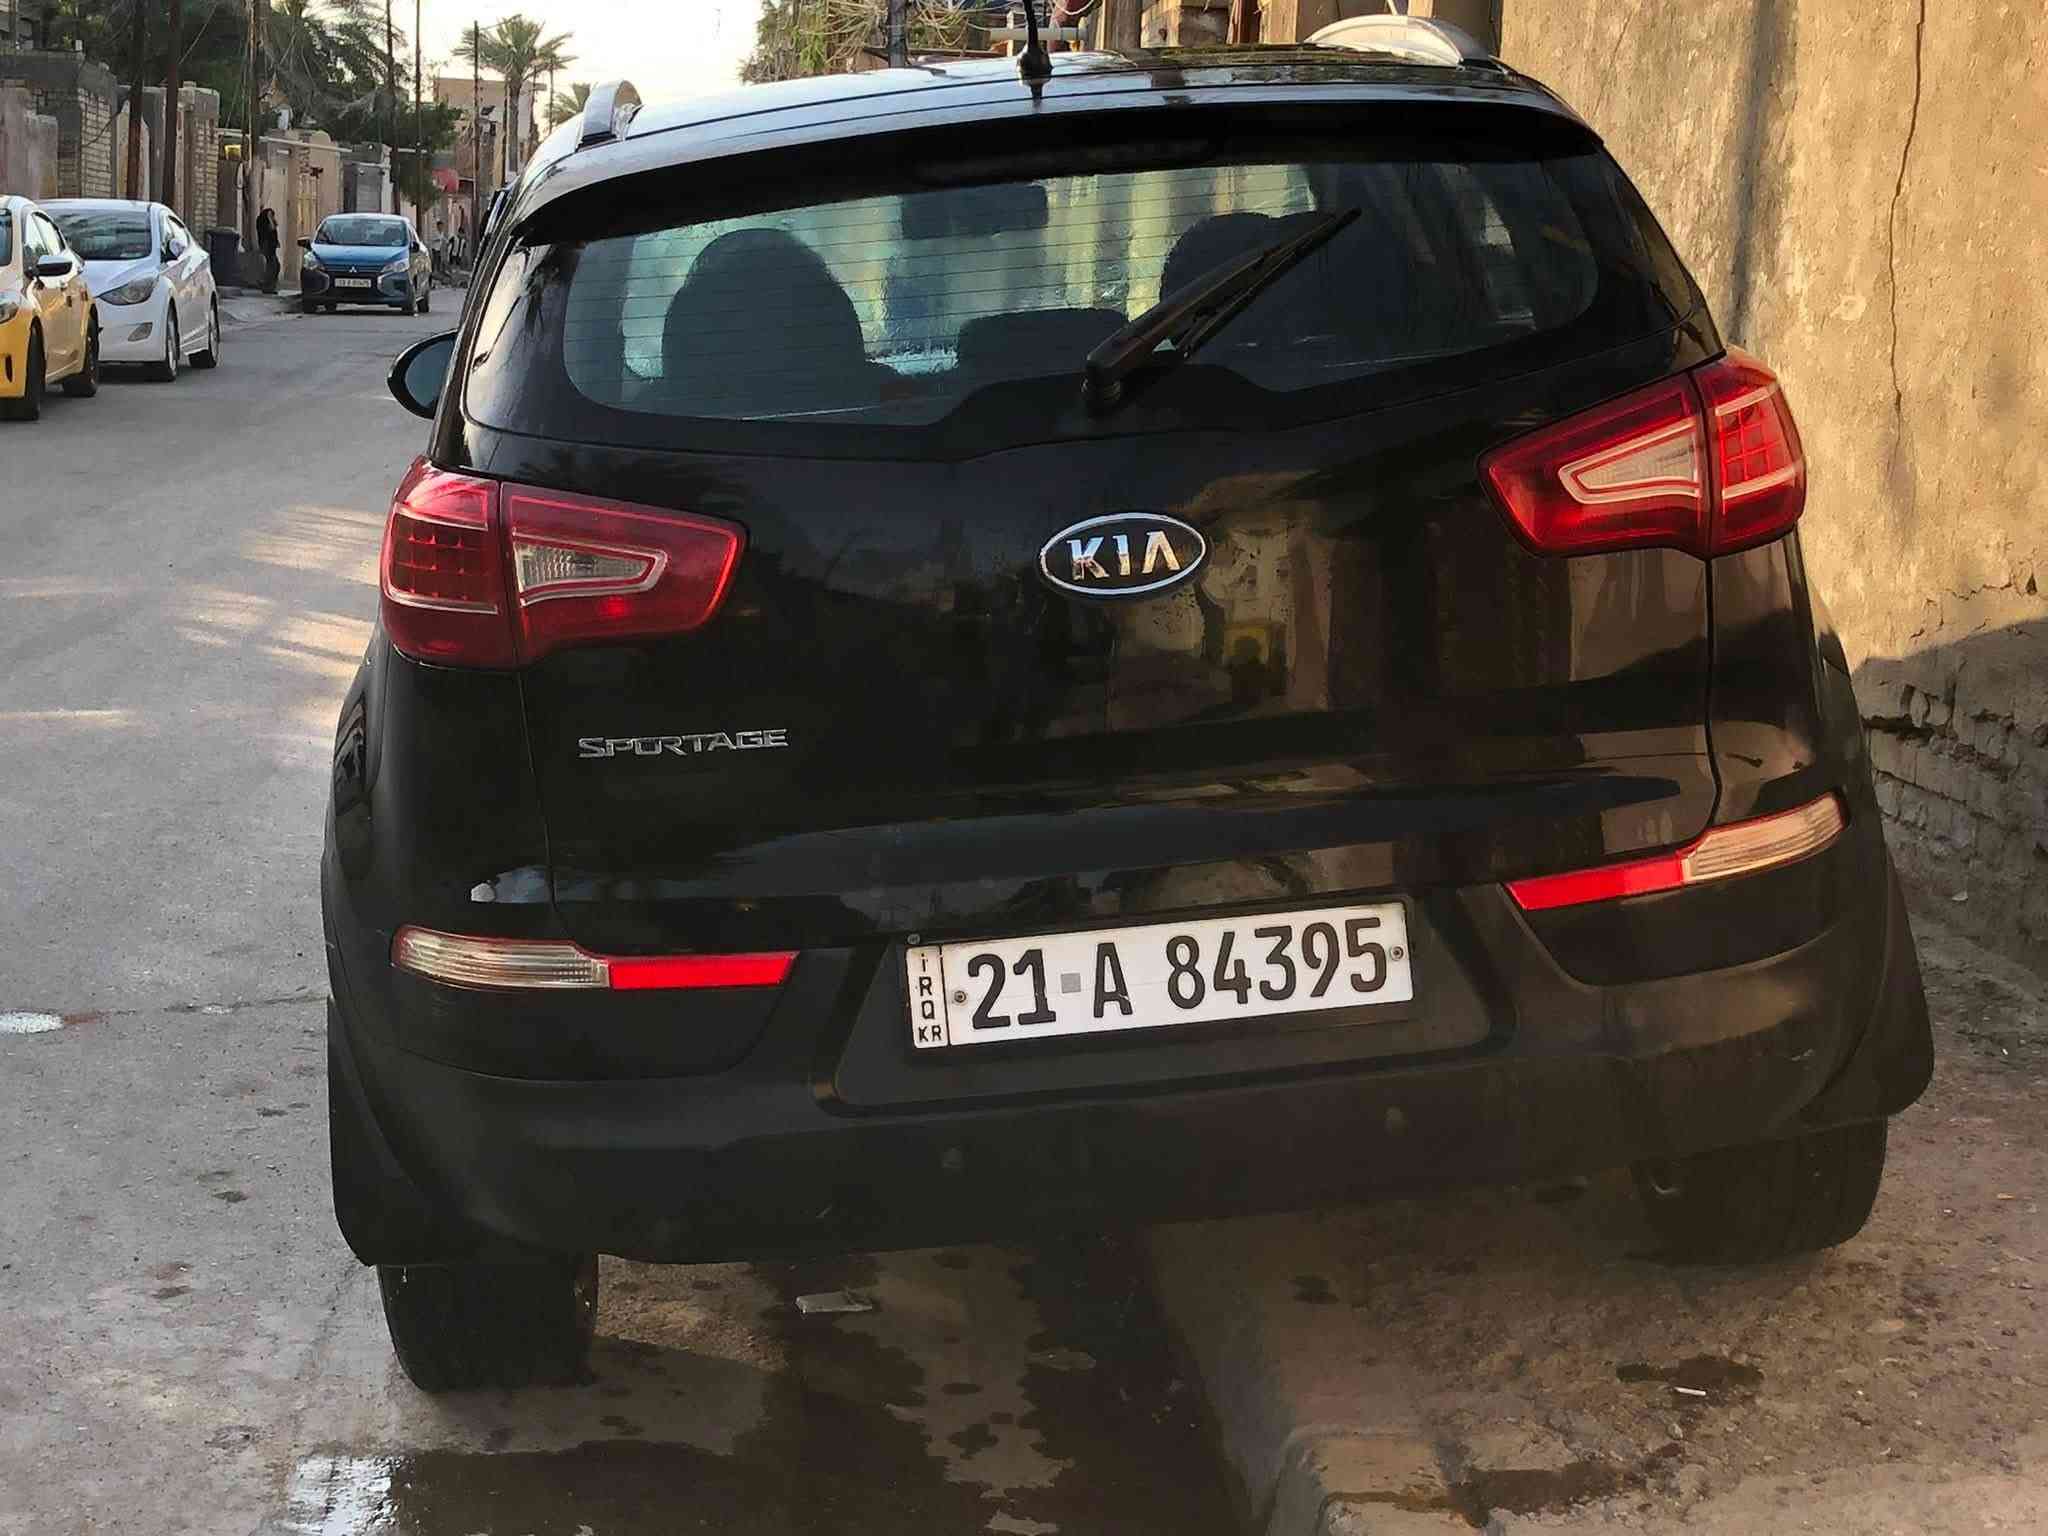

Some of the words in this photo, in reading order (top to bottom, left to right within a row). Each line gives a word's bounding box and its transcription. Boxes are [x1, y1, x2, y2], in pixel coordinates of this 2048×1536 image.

[1066, 530, 1181, 581] KIA
[578, 728, 789, 758] SPORTAGE
[967, 948, 1057, 1030] 21
[1092, 941, 1134, 1019] A
[1165, 916, 1388, 1010] 84395
[918, 1024, 942, 1043] KR
